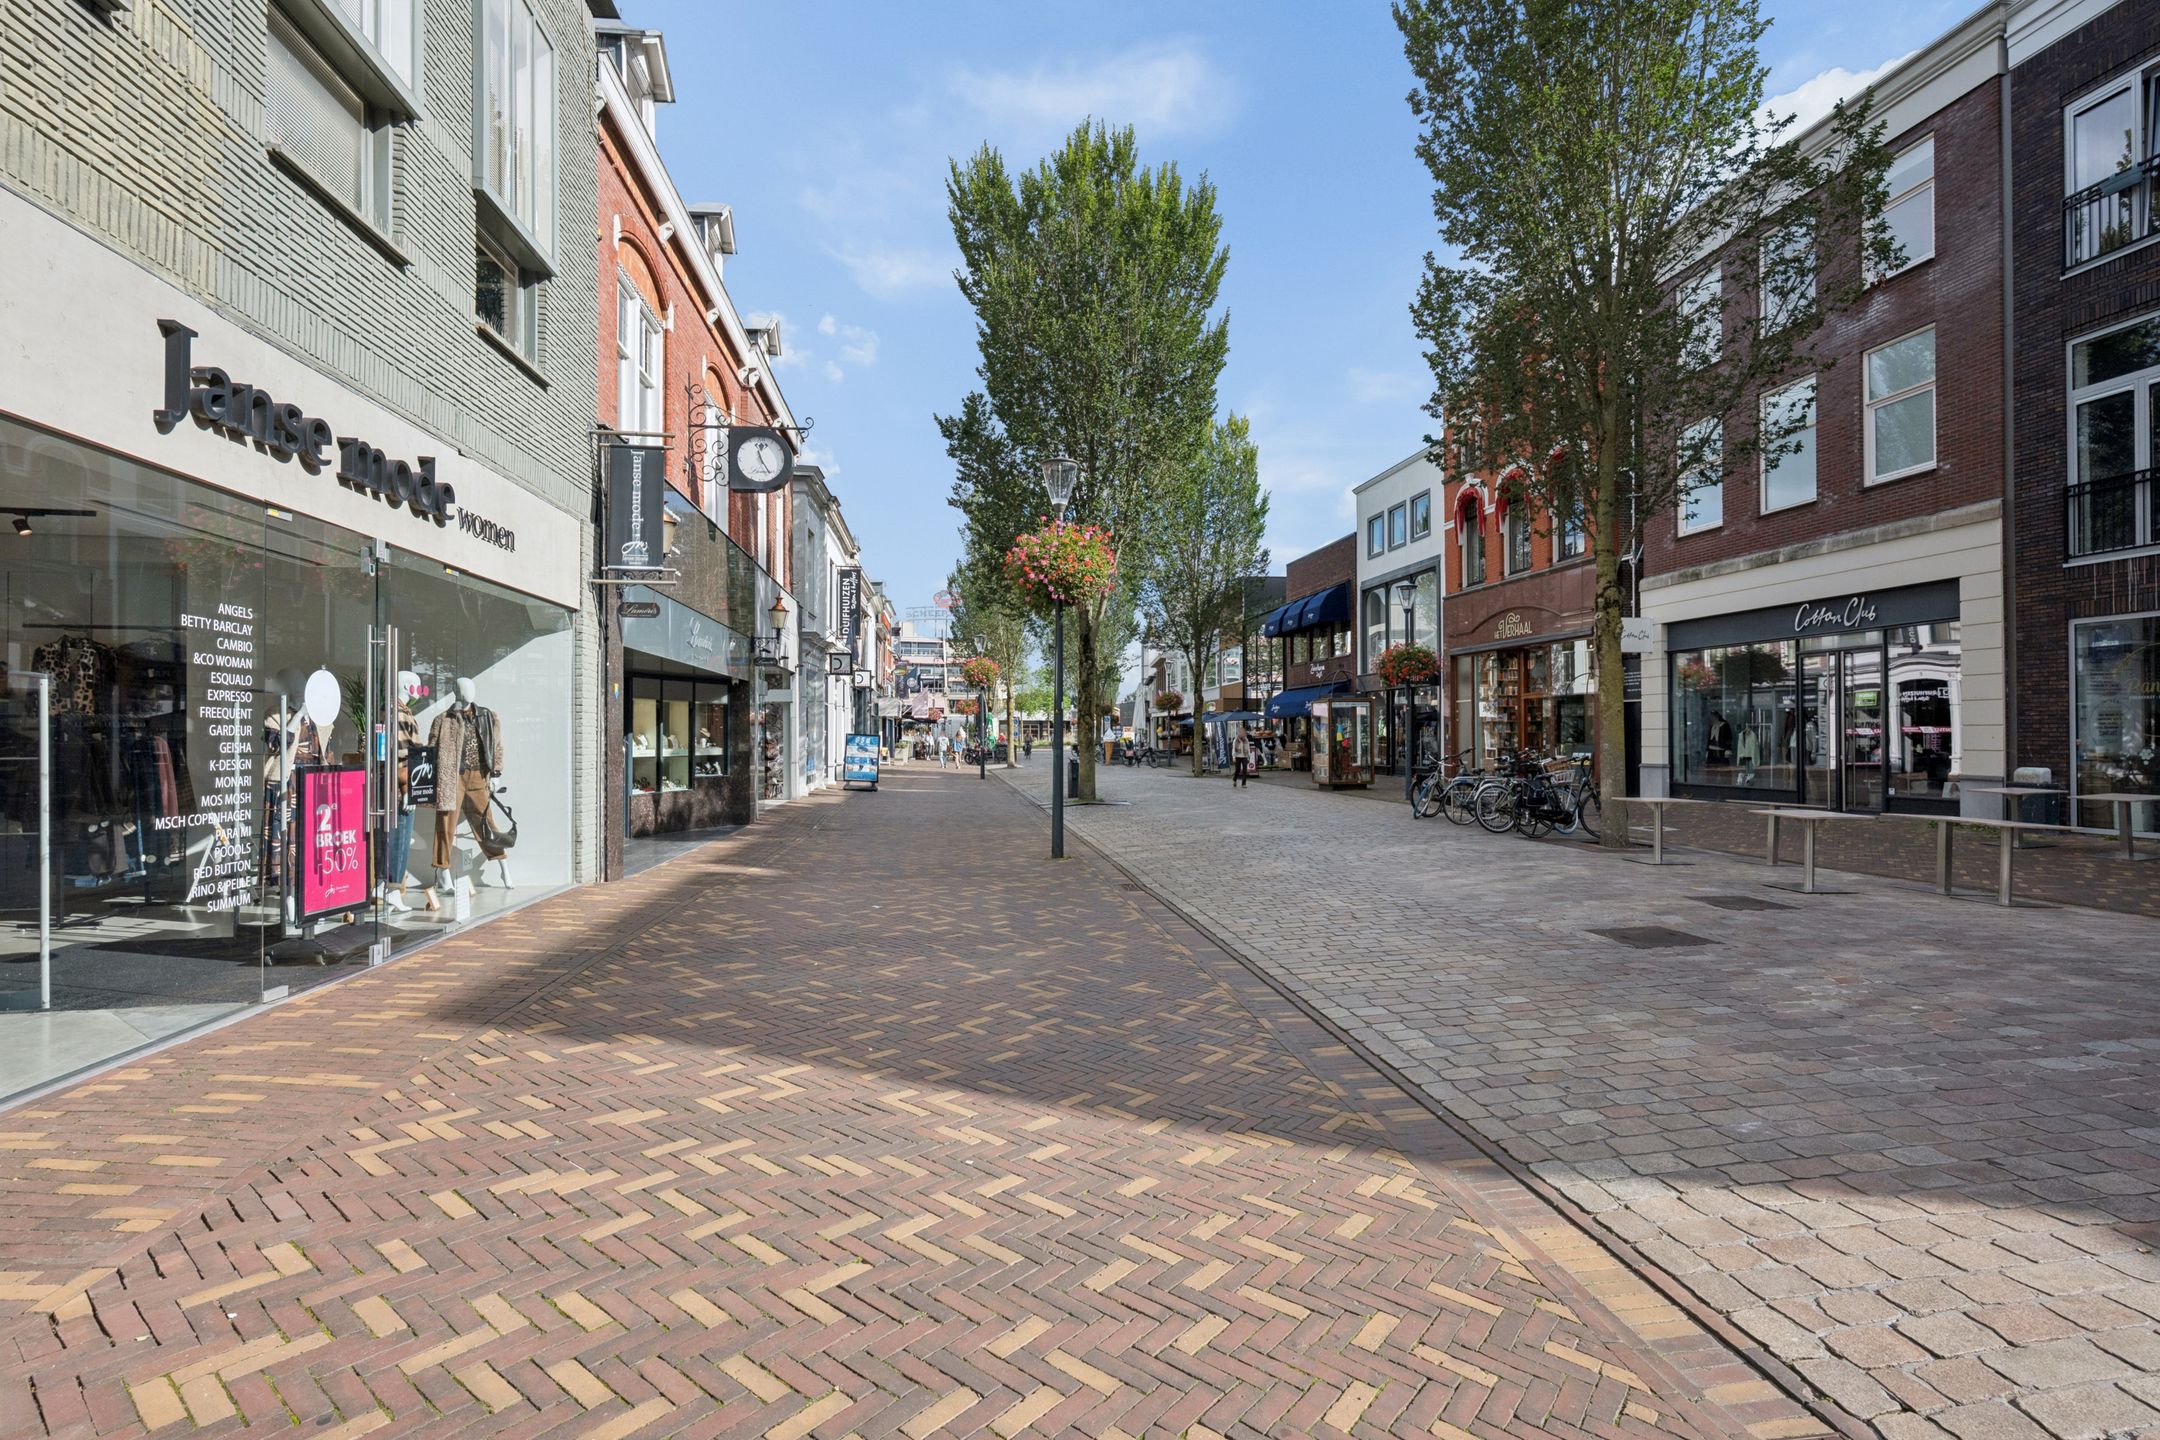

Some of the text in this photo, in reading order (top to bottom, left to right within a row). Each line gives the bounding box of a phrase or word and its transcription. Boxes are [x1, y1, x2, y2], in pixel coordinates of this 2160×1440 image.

[153, 319, 515, 551] Janse mode women
[630, 449, 645, 530] Janse mode
[218, 603, 253, 619] ANGELS
[842, 578, 850, 634] DUIFHUIZEN
[1794, 597, 1877, 632] Cotton Club
[181, 614, 253, 636] BETTY BARCLAY
[217, 638, 253, 652] CAMBIO
[193, 652, 253, 669] &CO WOMAN
[211, 672, 253, 686] ESQUALO
[207, 689, 253, 703] EXPRESSO
[200, 706, 253, 719] FREEQUENT
[209, 724, 252, 736] GARDEUR
[219, 742, 252, 753] GEISHA
[209, 759, 252, 772] K-DESIGN
[215, 775, 252, 788] MONARI
[201, 792, 251, 807] MOS MOSH
[155, 809, 251, 831] MSCH COPENHAGEN
[241, 826, 251, 836] MI
[316, 830, 356, 848] BROEK
[214, 842, 251, 860] POOOLS
[193, 859, 251, 879] RED BUTTON
[322, 847, 358, 874] 50%
[207, 892, 251, 913] SUMMUM
